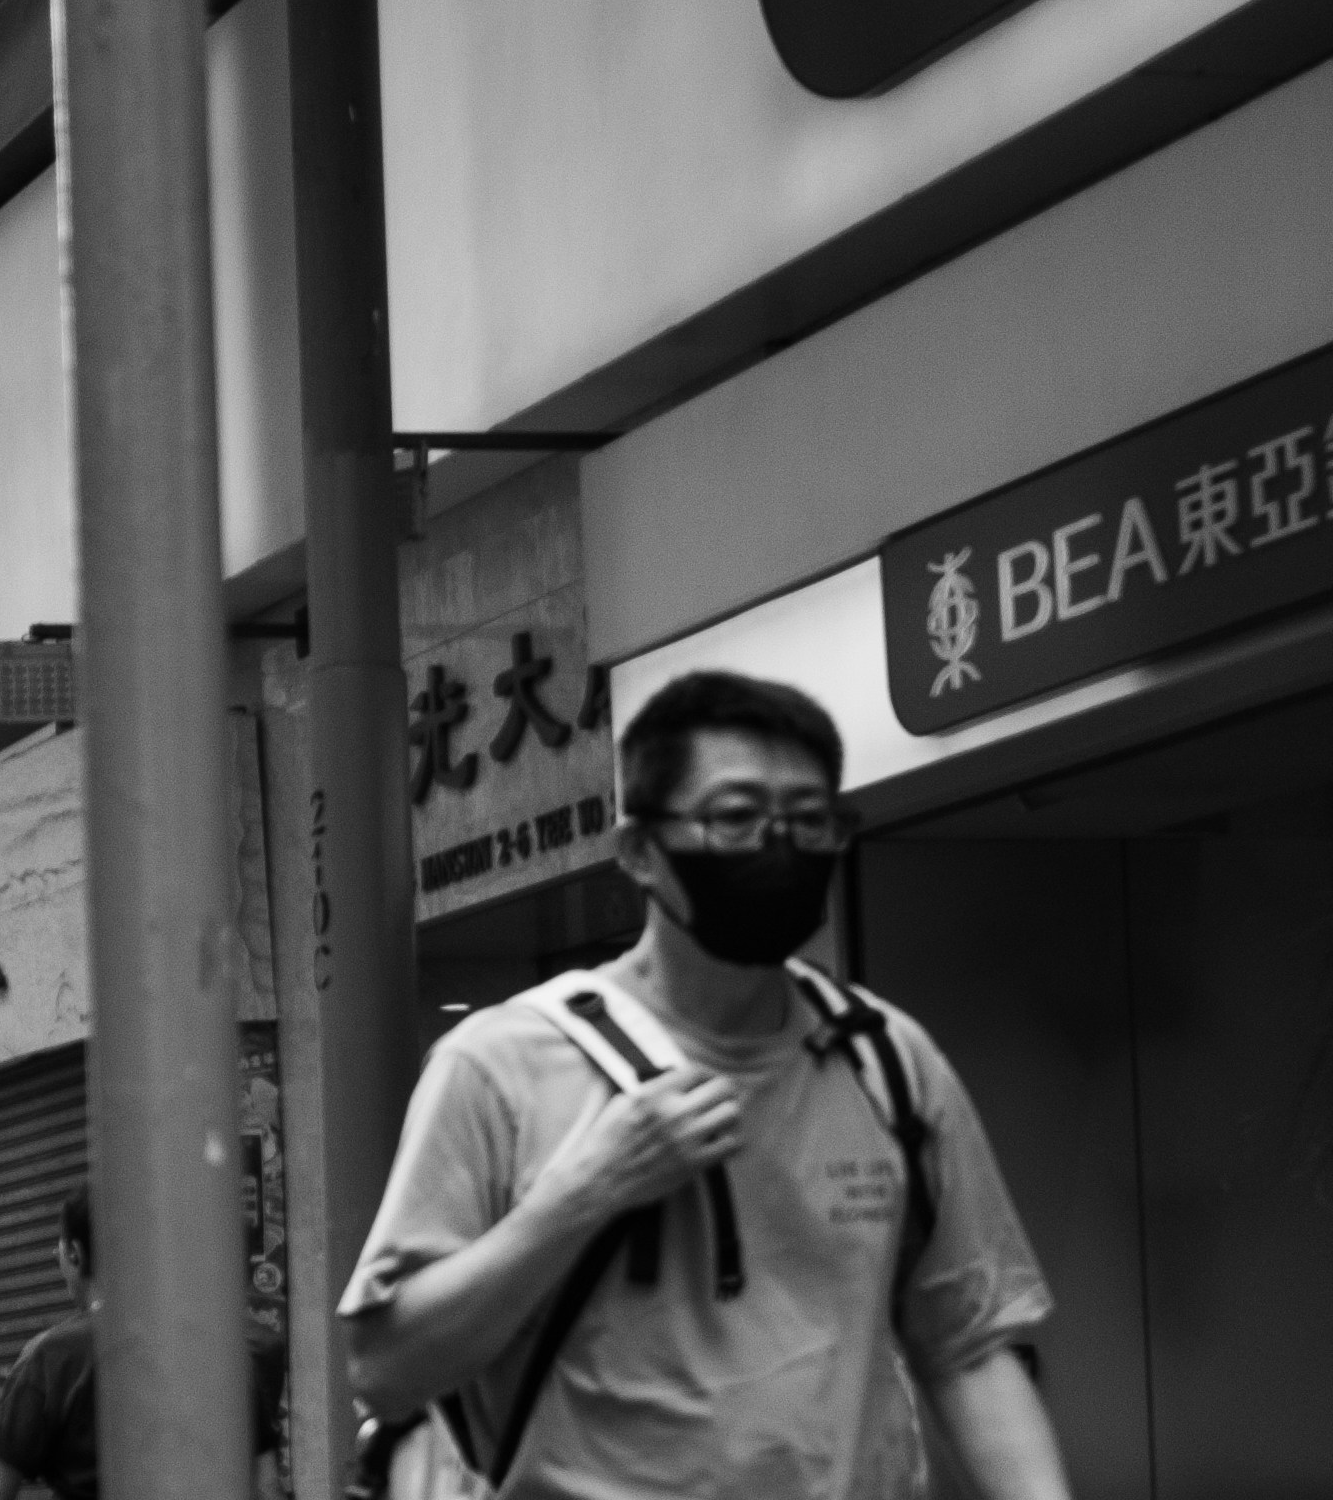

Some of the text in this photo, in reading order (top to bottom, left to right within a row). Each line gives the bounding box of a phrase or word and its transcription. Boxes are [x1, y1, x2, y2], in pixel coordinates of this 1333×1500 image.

[997, 497, 1168, 643] BEA
[1174, 422, 1333, 576] 東亞
[497, 821, 533, 869] 2-6
